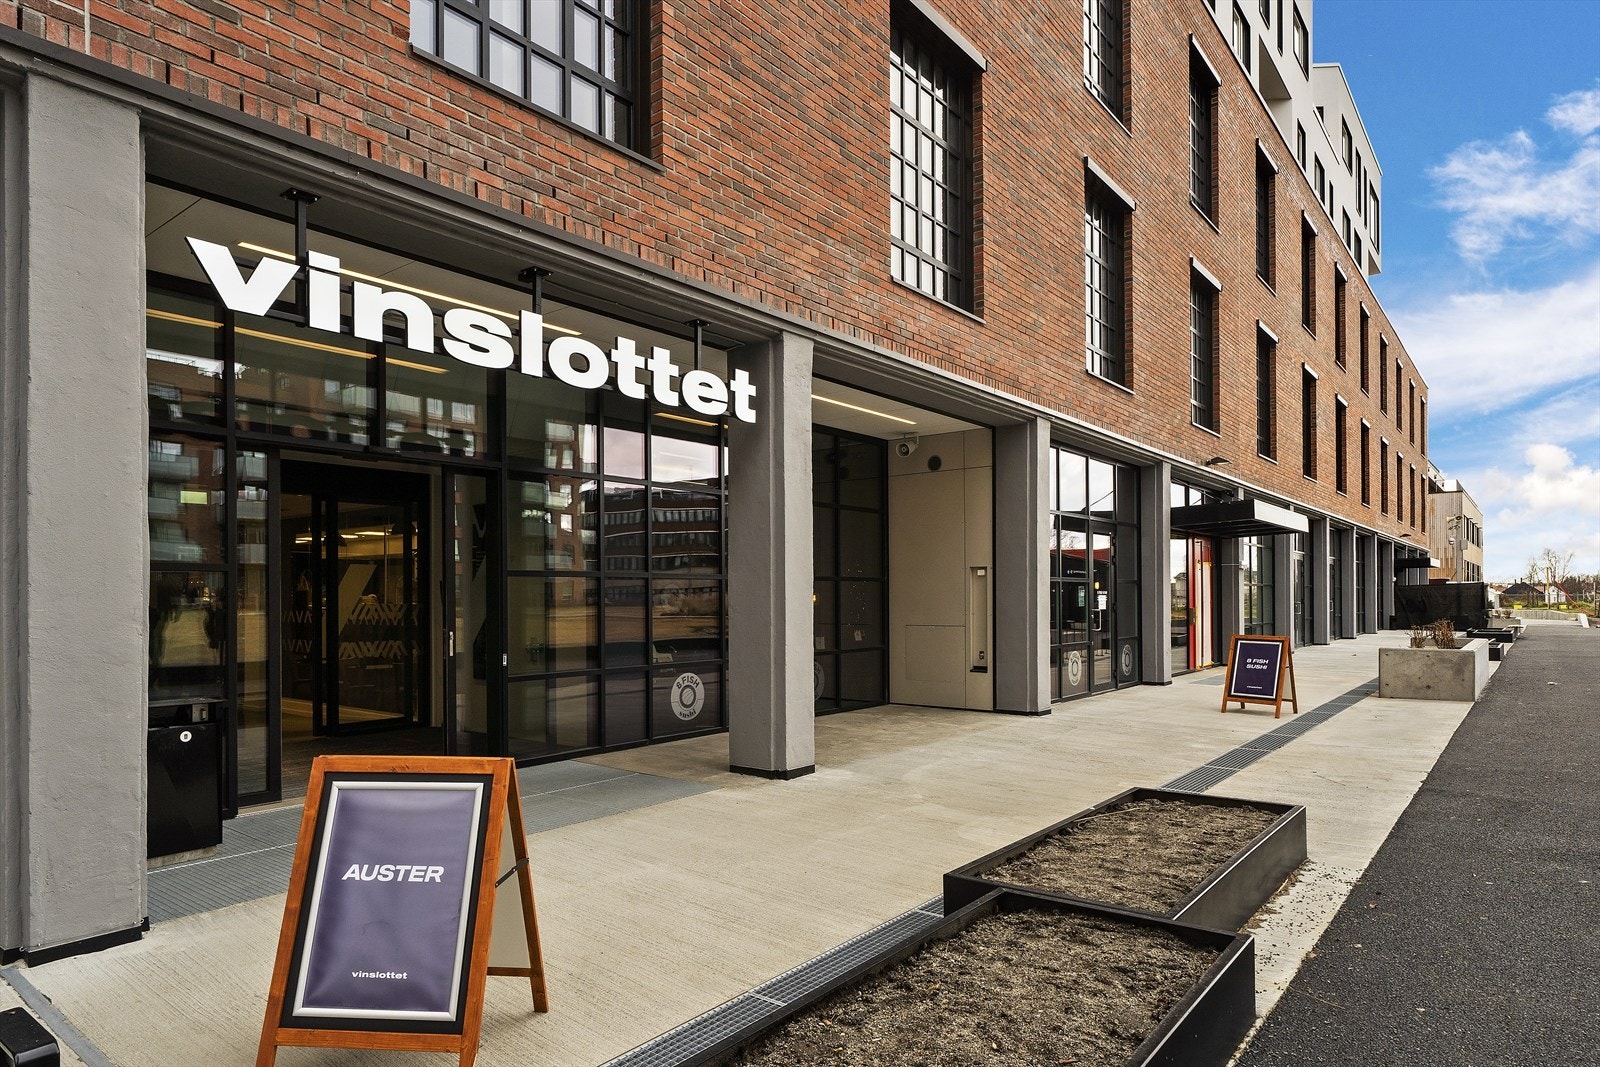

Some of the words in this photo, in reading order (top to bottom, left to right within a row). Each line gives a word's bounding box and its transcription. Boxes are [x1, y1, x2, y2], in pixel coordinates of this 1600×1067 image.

[184, 236, 757, 424] vinslottet
[682, 675, 700, 688] FISH
[341, 864, 445, 883] AUSTER
[351, 970, 408, 980] vinslottet
